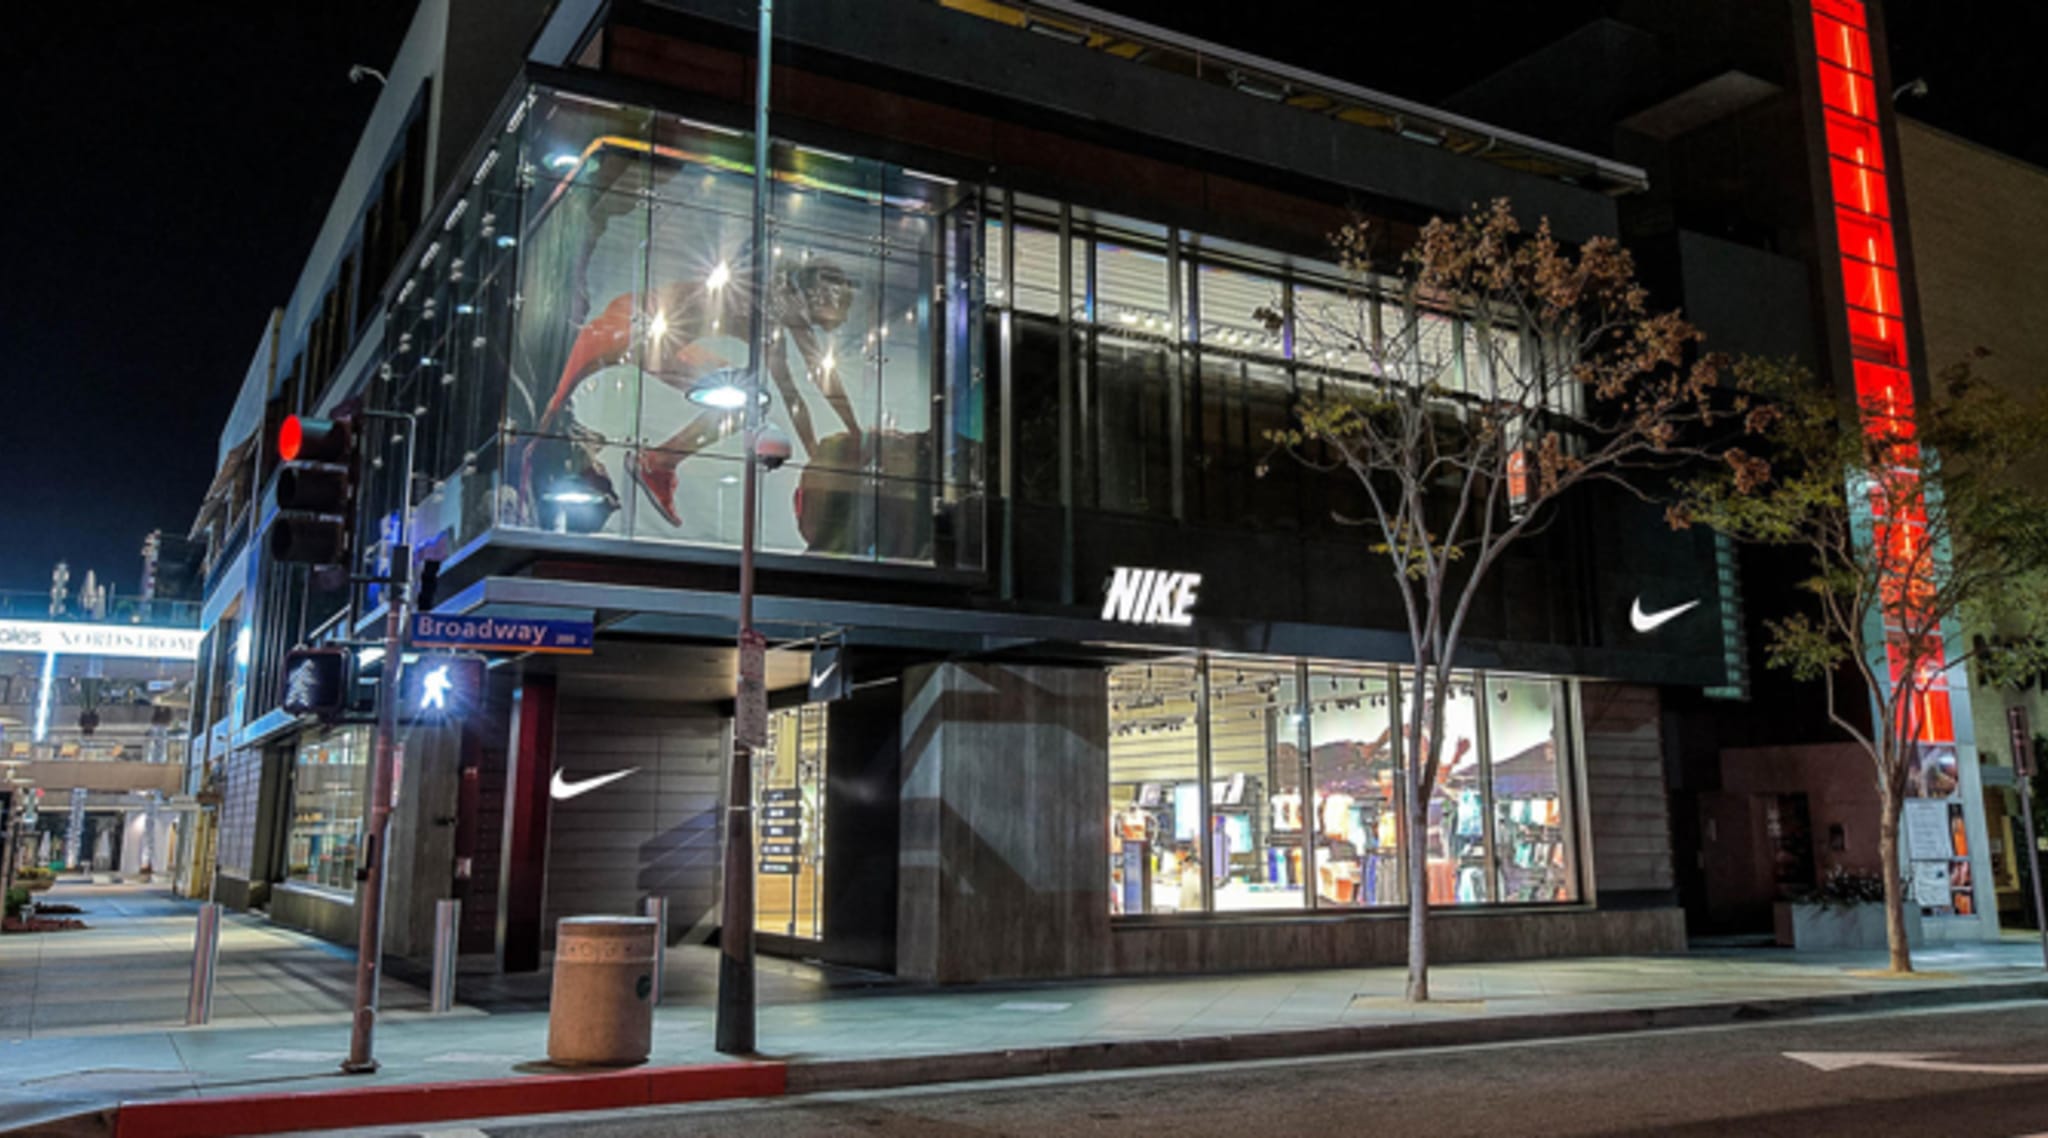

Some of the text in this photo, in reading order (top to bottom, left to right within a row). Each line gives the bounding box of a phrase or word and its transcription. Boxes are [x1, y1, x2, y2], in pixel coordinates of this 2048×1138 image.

[1100, 566, 1203, 626] NIKE
[58, 630, 195, 652] NORDSTROM
[417, 615, 547, 645] Broadway
